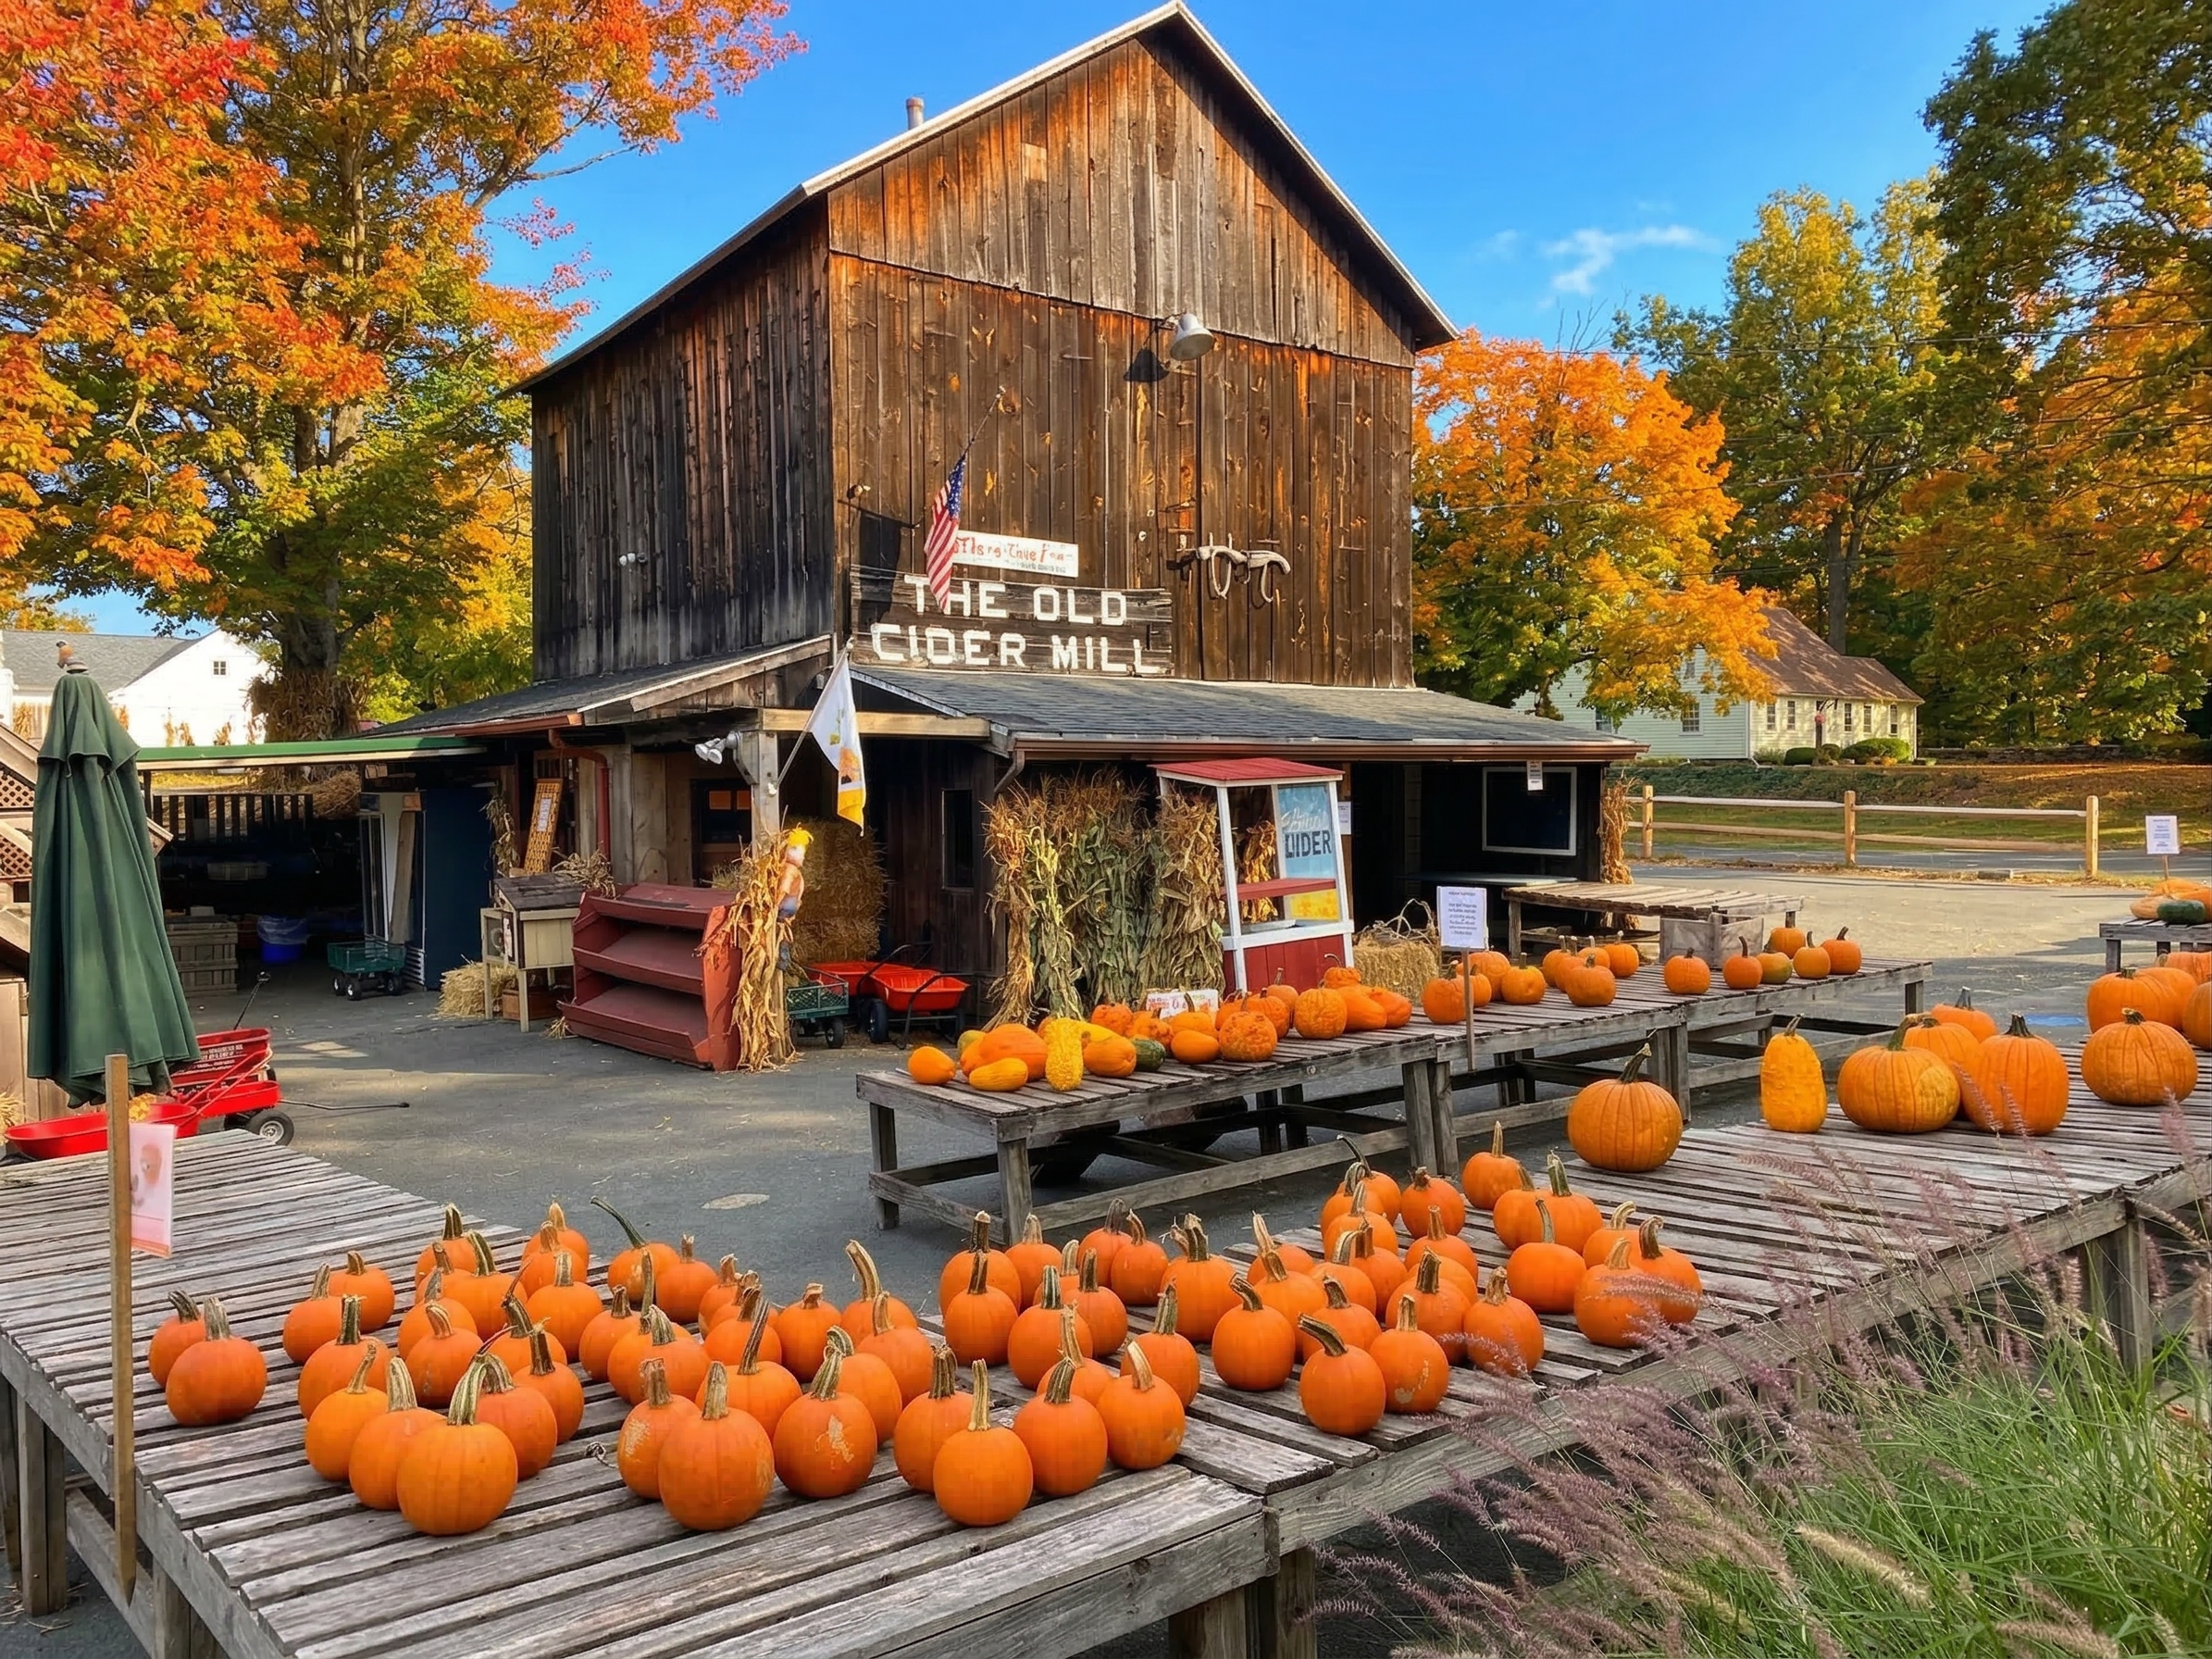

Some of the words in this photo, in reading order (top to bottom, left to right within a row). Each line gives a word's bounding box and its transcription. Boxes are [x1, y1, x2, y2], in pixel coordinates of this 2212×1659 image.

[904, 575, 1007, 617] THE
[1033, 587, 1126, 626] OLD
[870, 622, 1026, 667] CIDER
[1051, 635, 1164, 674] MILL
